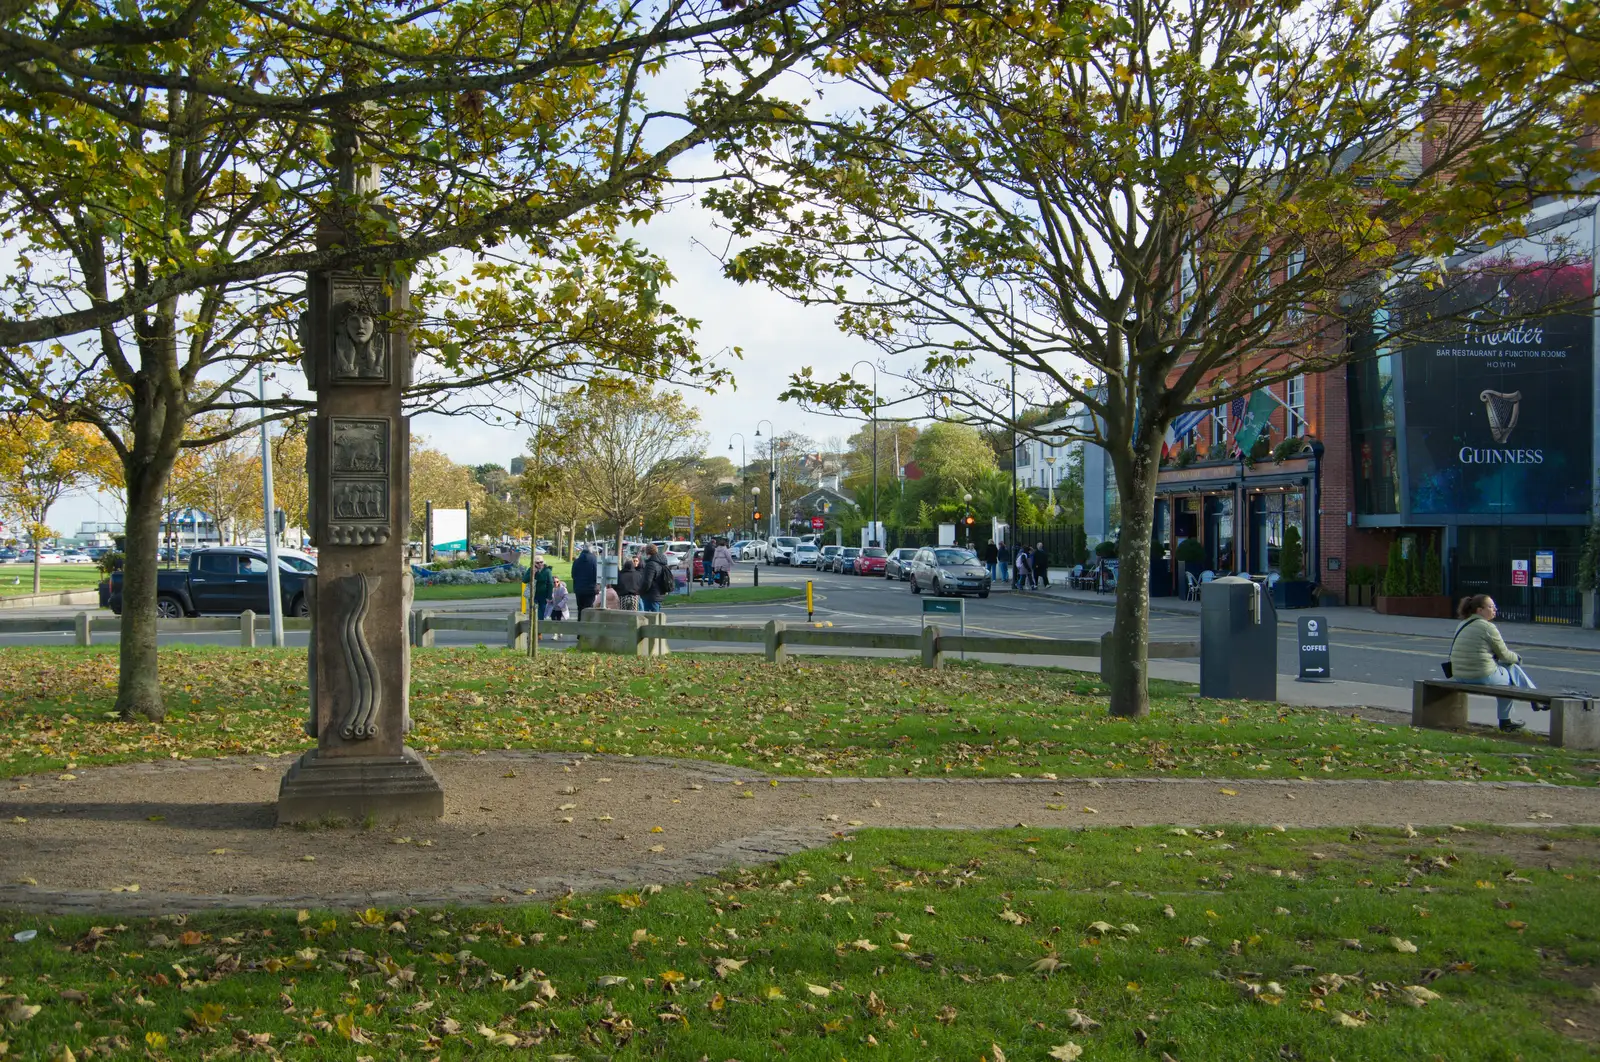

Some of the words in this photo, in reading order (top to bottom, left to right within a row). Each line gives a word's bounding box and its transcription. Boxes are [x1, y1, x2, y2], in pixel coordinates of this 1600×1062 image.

[1436, 349, 1451, 357] BAR
[1452, 349, 1497, 357] RESTAURANT
[1505, 350, 1540, 358] FUNCTION
[1541, 350, 1566, 358] ROOMS
[1459, 447, 1543, 463] GUINNESS
